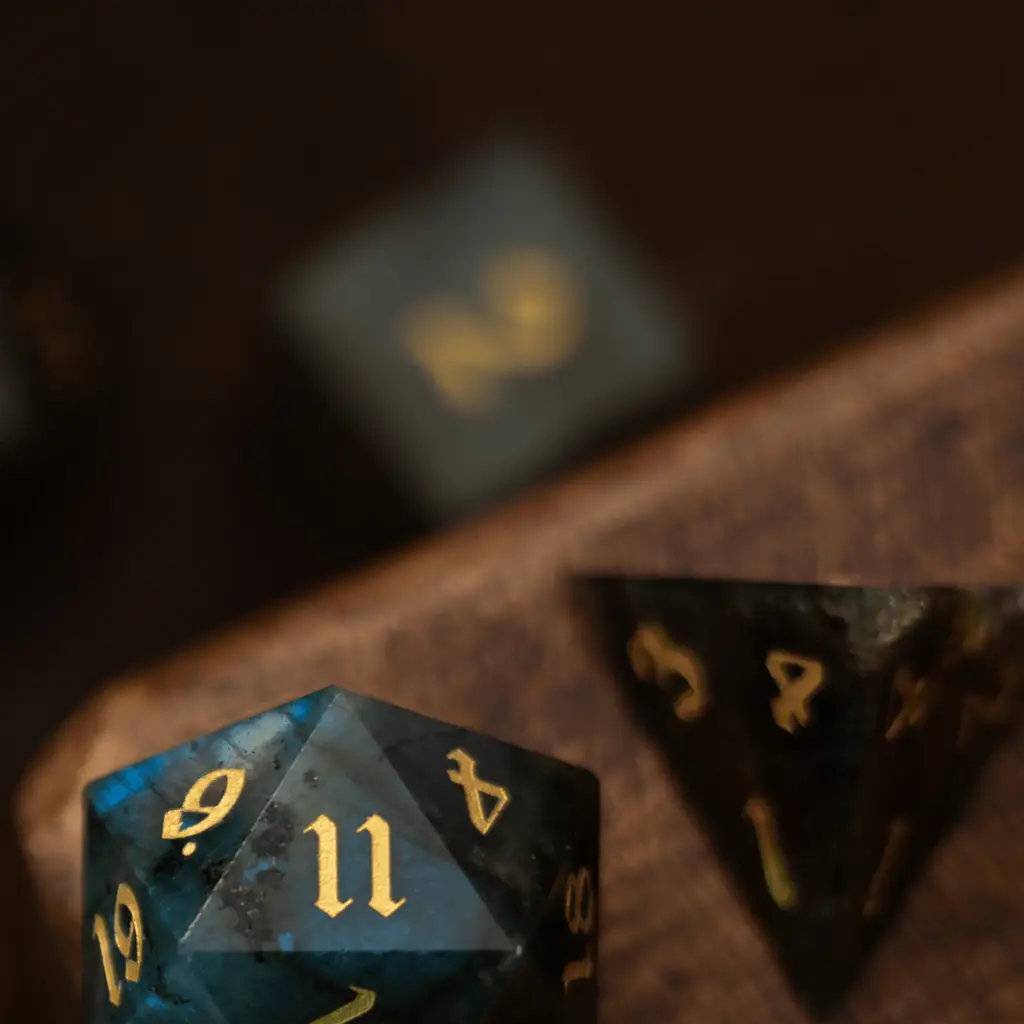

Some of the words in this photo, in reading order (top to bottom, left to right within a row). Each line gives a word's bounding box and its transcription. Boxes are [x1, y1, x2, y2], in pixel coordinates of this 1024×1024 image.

[766, 650, 826, 733] 4
[447, 748, 511, 836] 4
[304, 813, 407, 919] 11
[93, 882, 144, 1007] 19
